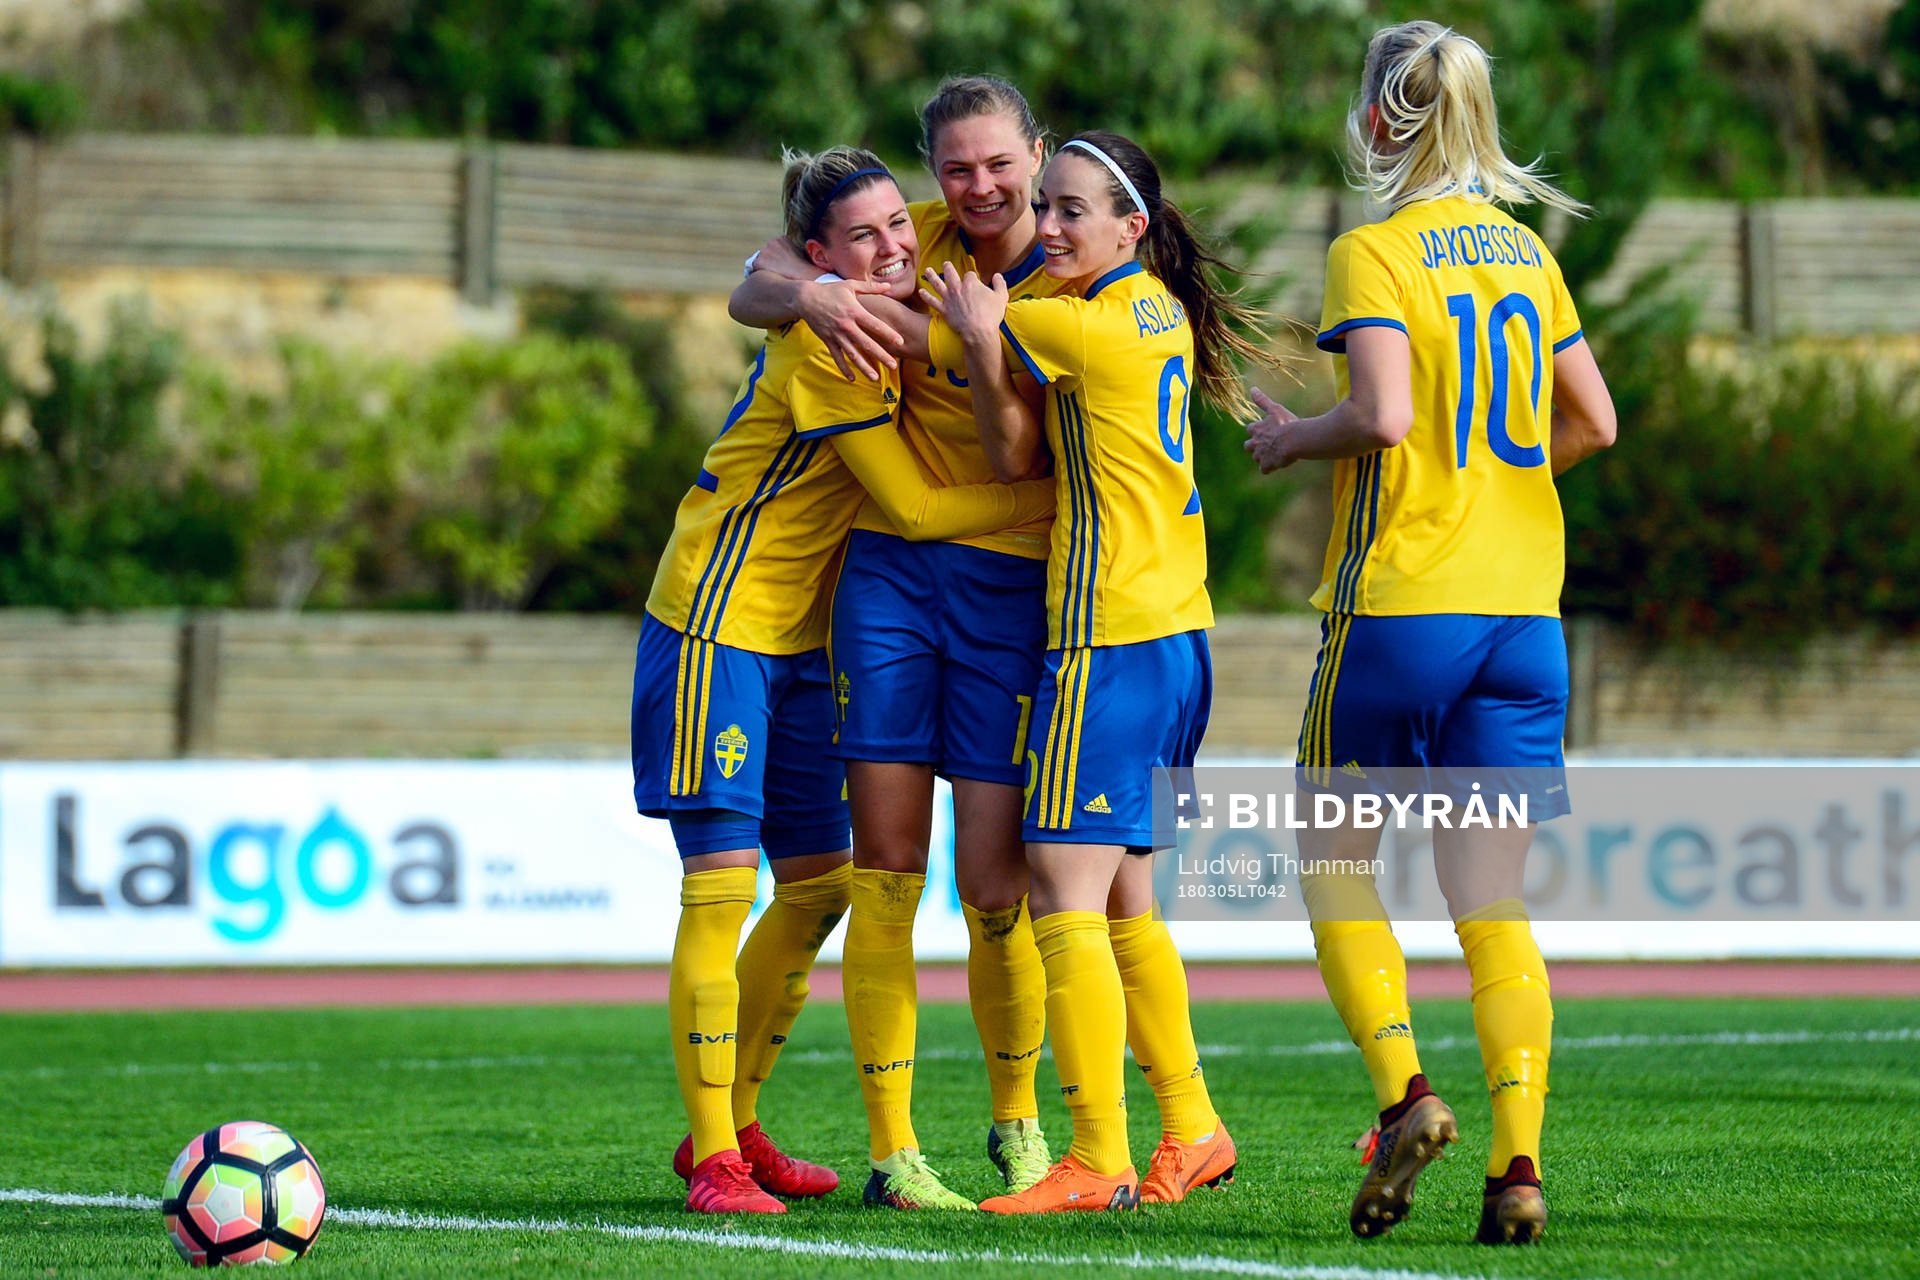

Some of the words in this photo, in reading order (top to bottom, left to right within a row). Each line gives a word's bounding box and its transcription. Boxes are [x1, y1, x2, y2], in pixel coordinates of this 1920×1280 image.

[1418, 223, 1543, 269] JAKOBSSON
[1446, 292, 1546, 470] 10
[52, 793, 461, 943] Lagoa
[862, 1059, 914, 1075] SvFF
